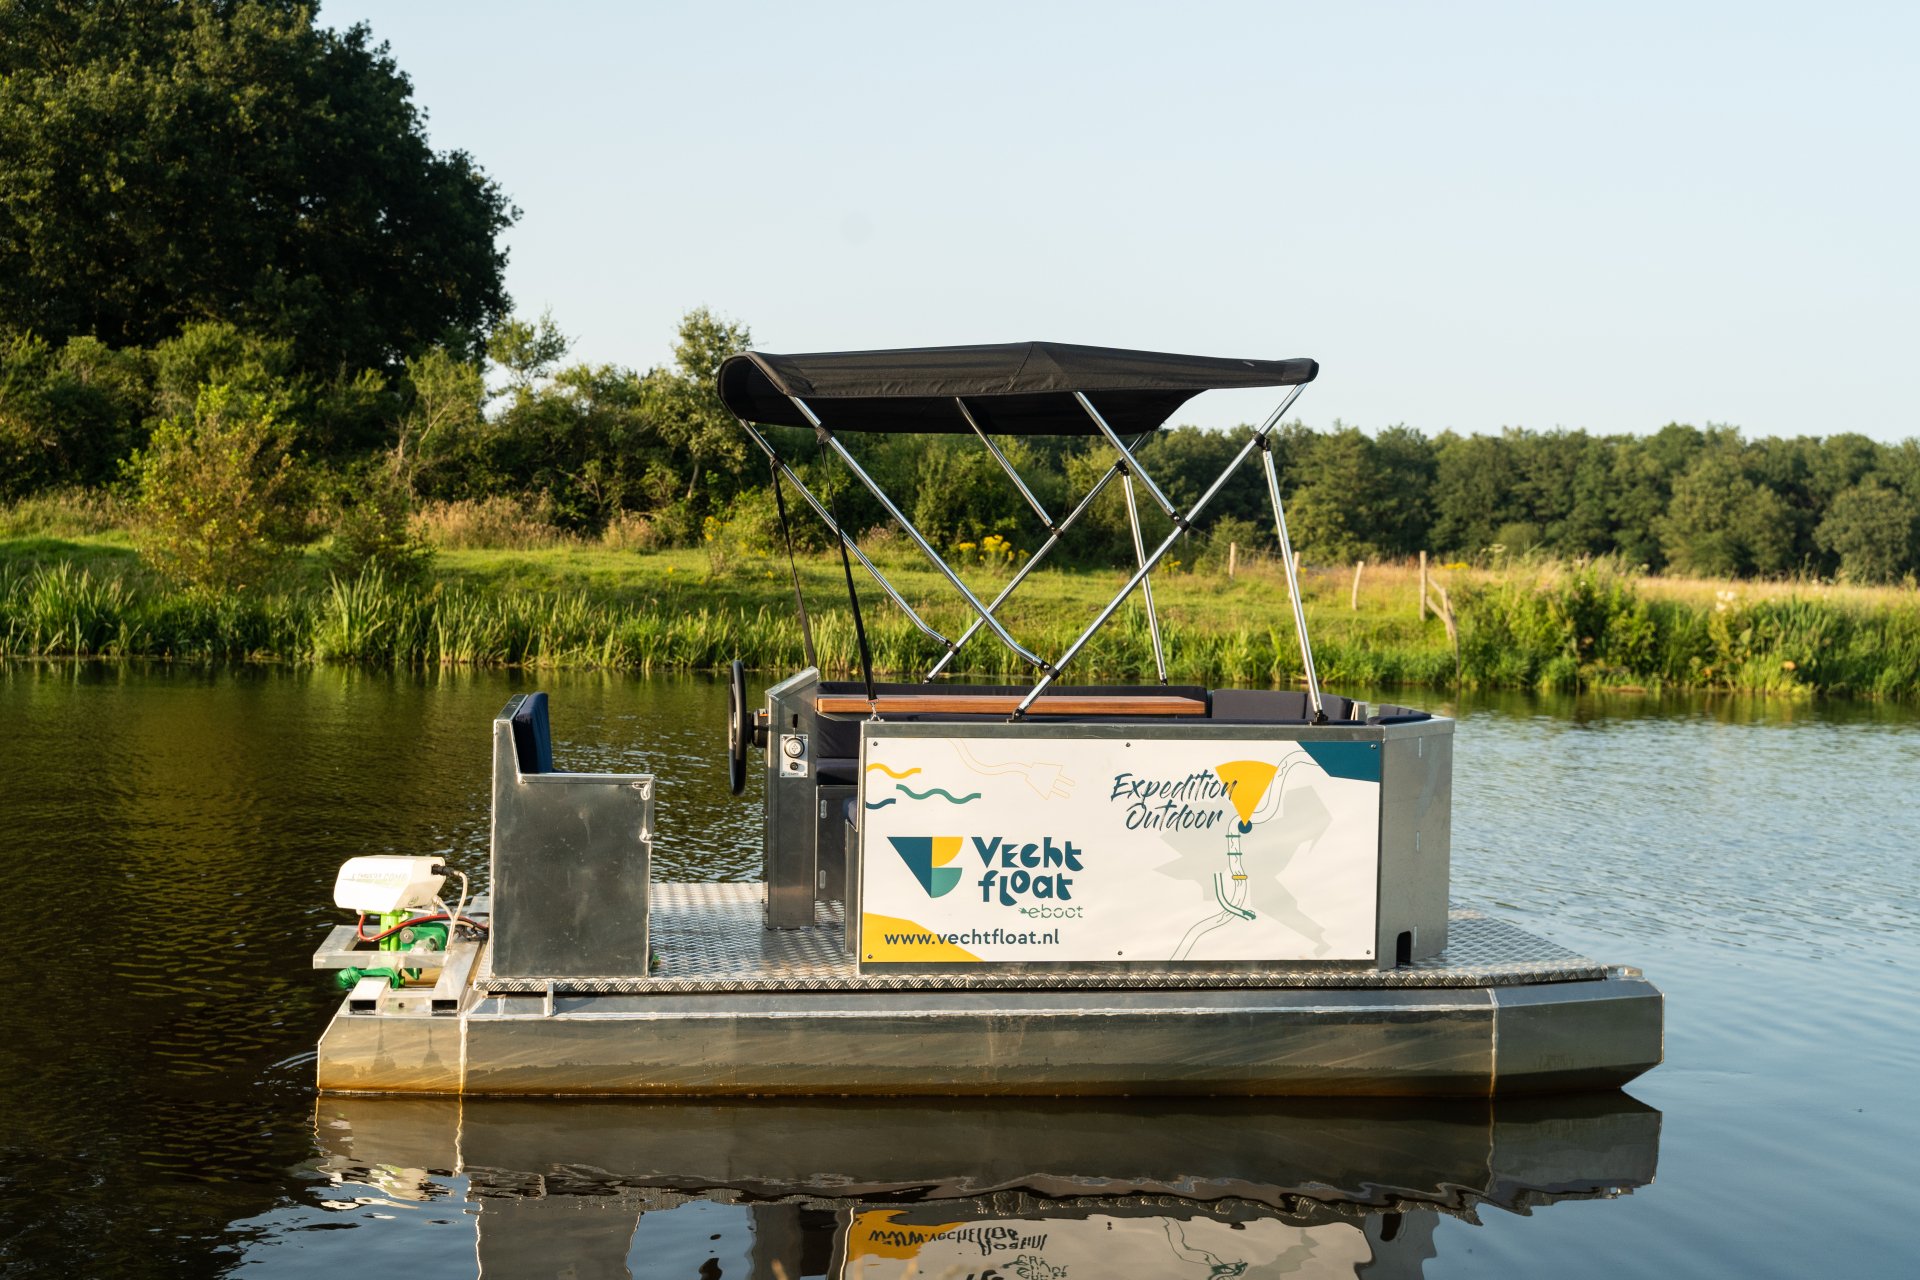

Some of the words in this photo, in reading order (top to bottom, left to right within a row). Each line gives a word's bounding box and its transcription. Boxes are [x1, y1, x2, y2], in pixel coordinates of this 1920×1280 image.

[1110, 769, 1237, 809] Expedition
[1126, 799, 1223, 832] Outdoor
[978, 869, 1073, 907] float
[1028, 904, 1083, 919] eboot
[885, 928, 1059, 945] www.vechtfloat.nl
